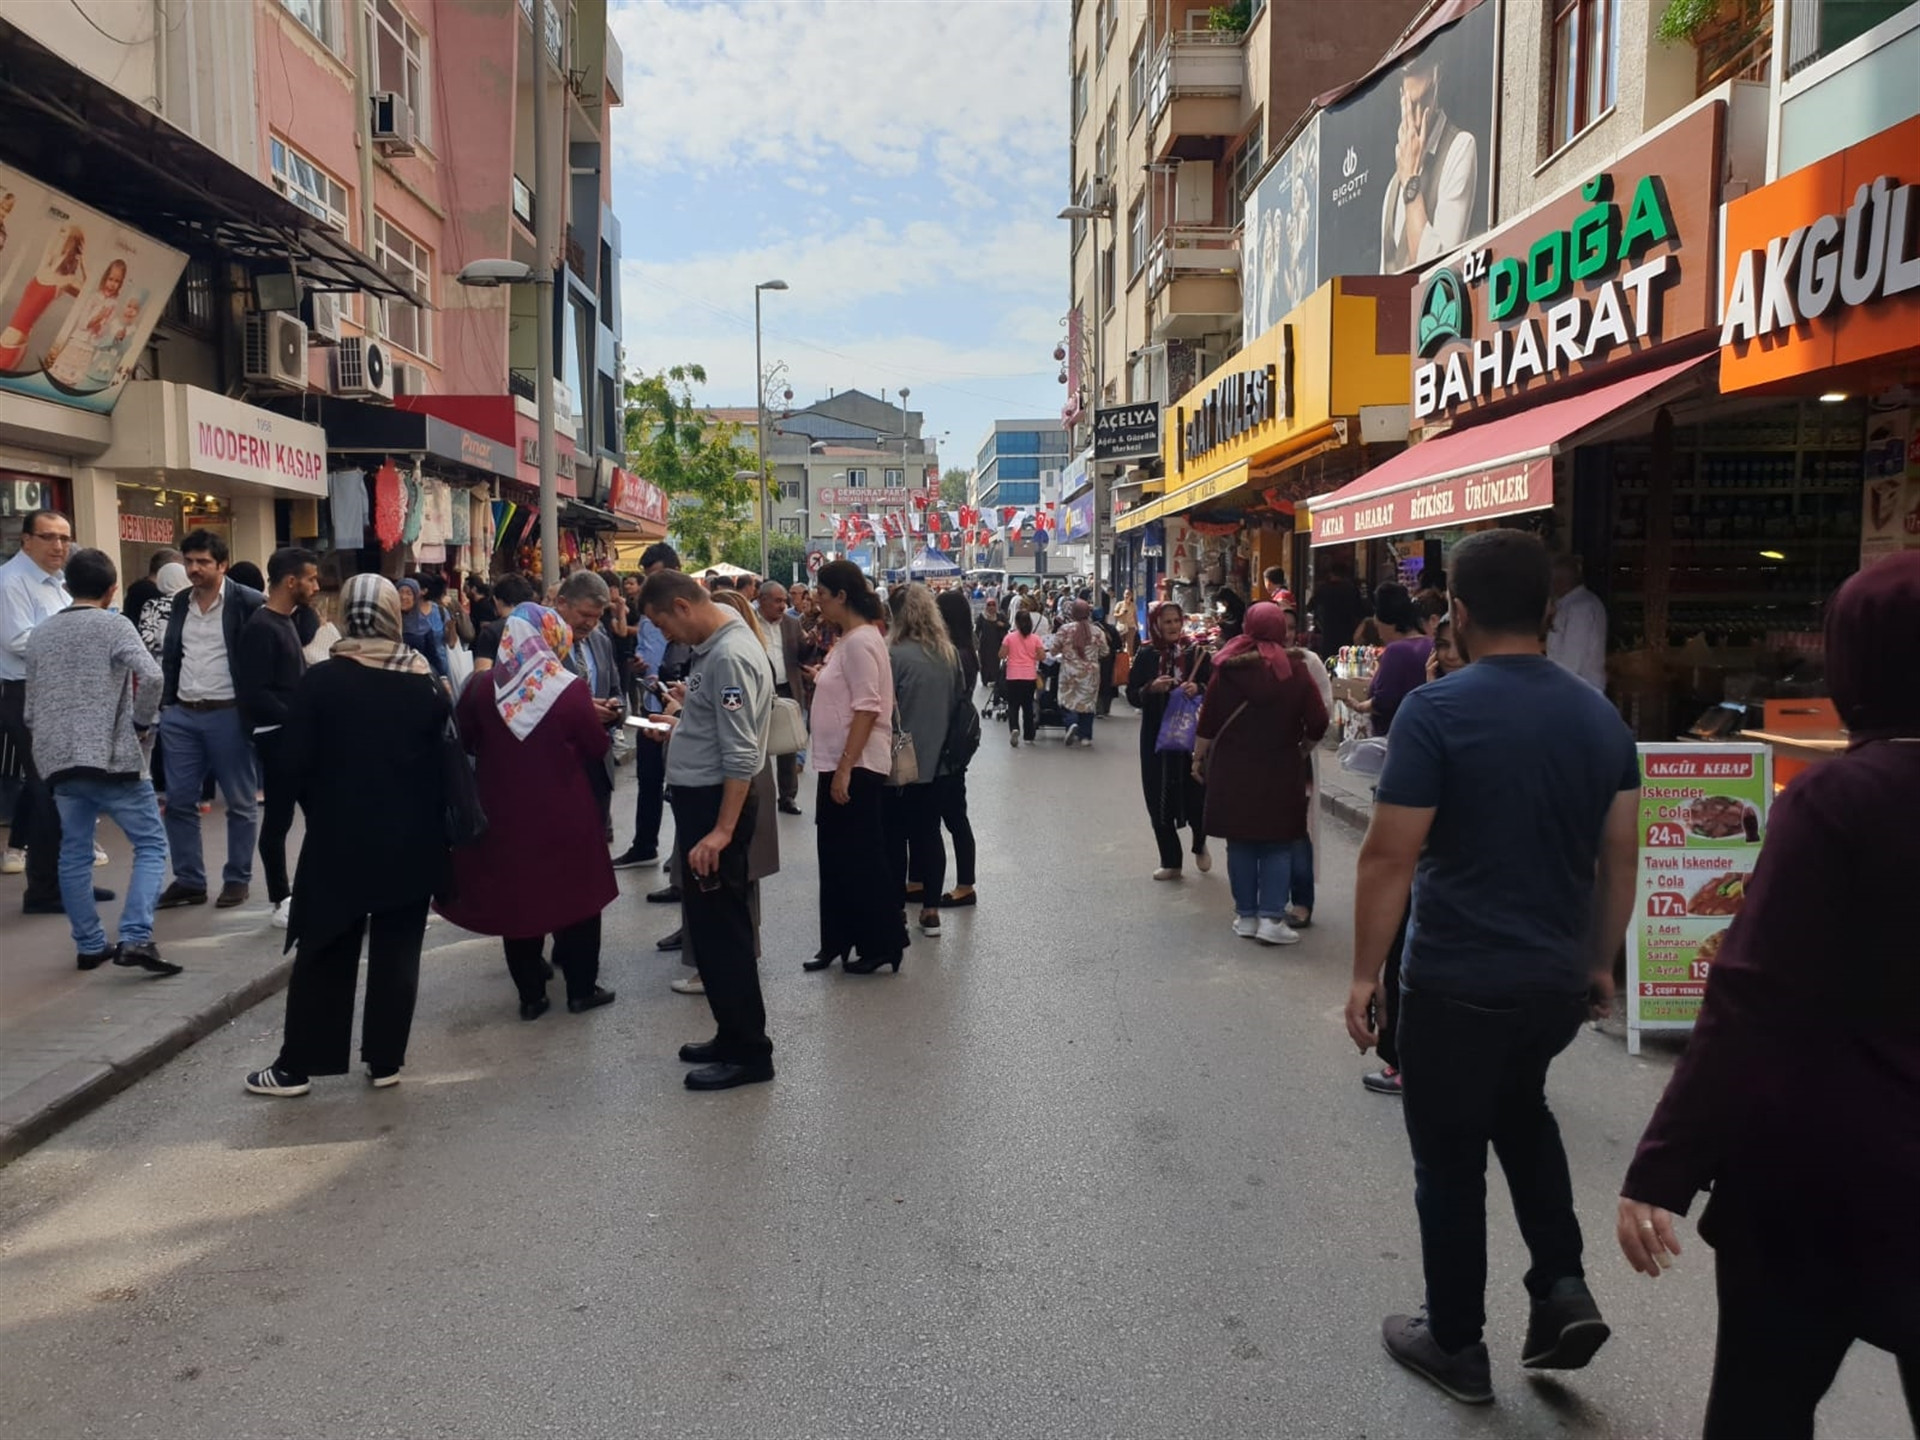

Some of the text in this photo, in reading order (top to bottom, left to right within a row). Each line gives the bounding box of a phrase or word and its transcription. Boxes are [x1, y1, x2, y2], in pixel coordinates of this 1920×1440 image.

[1332, 169, 1369, 202] BIGOTTI
[1488, 173, 1668, 322] DOĞA
[1719, 174, 1920, 347] AKGÜL
[1414, 254, 1667, 419] BAHARAT
[1097, 409, 1156, 433] AÇELYA
[198, 421, 322, 481] MODERN KASAP
[1410, 463, 1529, 520] BİTKİSEL ÜRÜNLERİ
[1354, 502, 1394, 531] BAHARAT
[1703, 763, 1750, 775] KEBAP
[1658, 805, 1690, 821] Cola
[1645, 856, 1679, 869] Tavuk
[1658, 874, 1685, 887] Cola
[1659, 925, 1680, 935] Adet
[1647, 938, 1698, 948] Lahmacun
[1647, 951, 1679, 961] Salata
[1656, 965, 1685, 976] Ayran
[1644, 983, 1654, 996] 3
